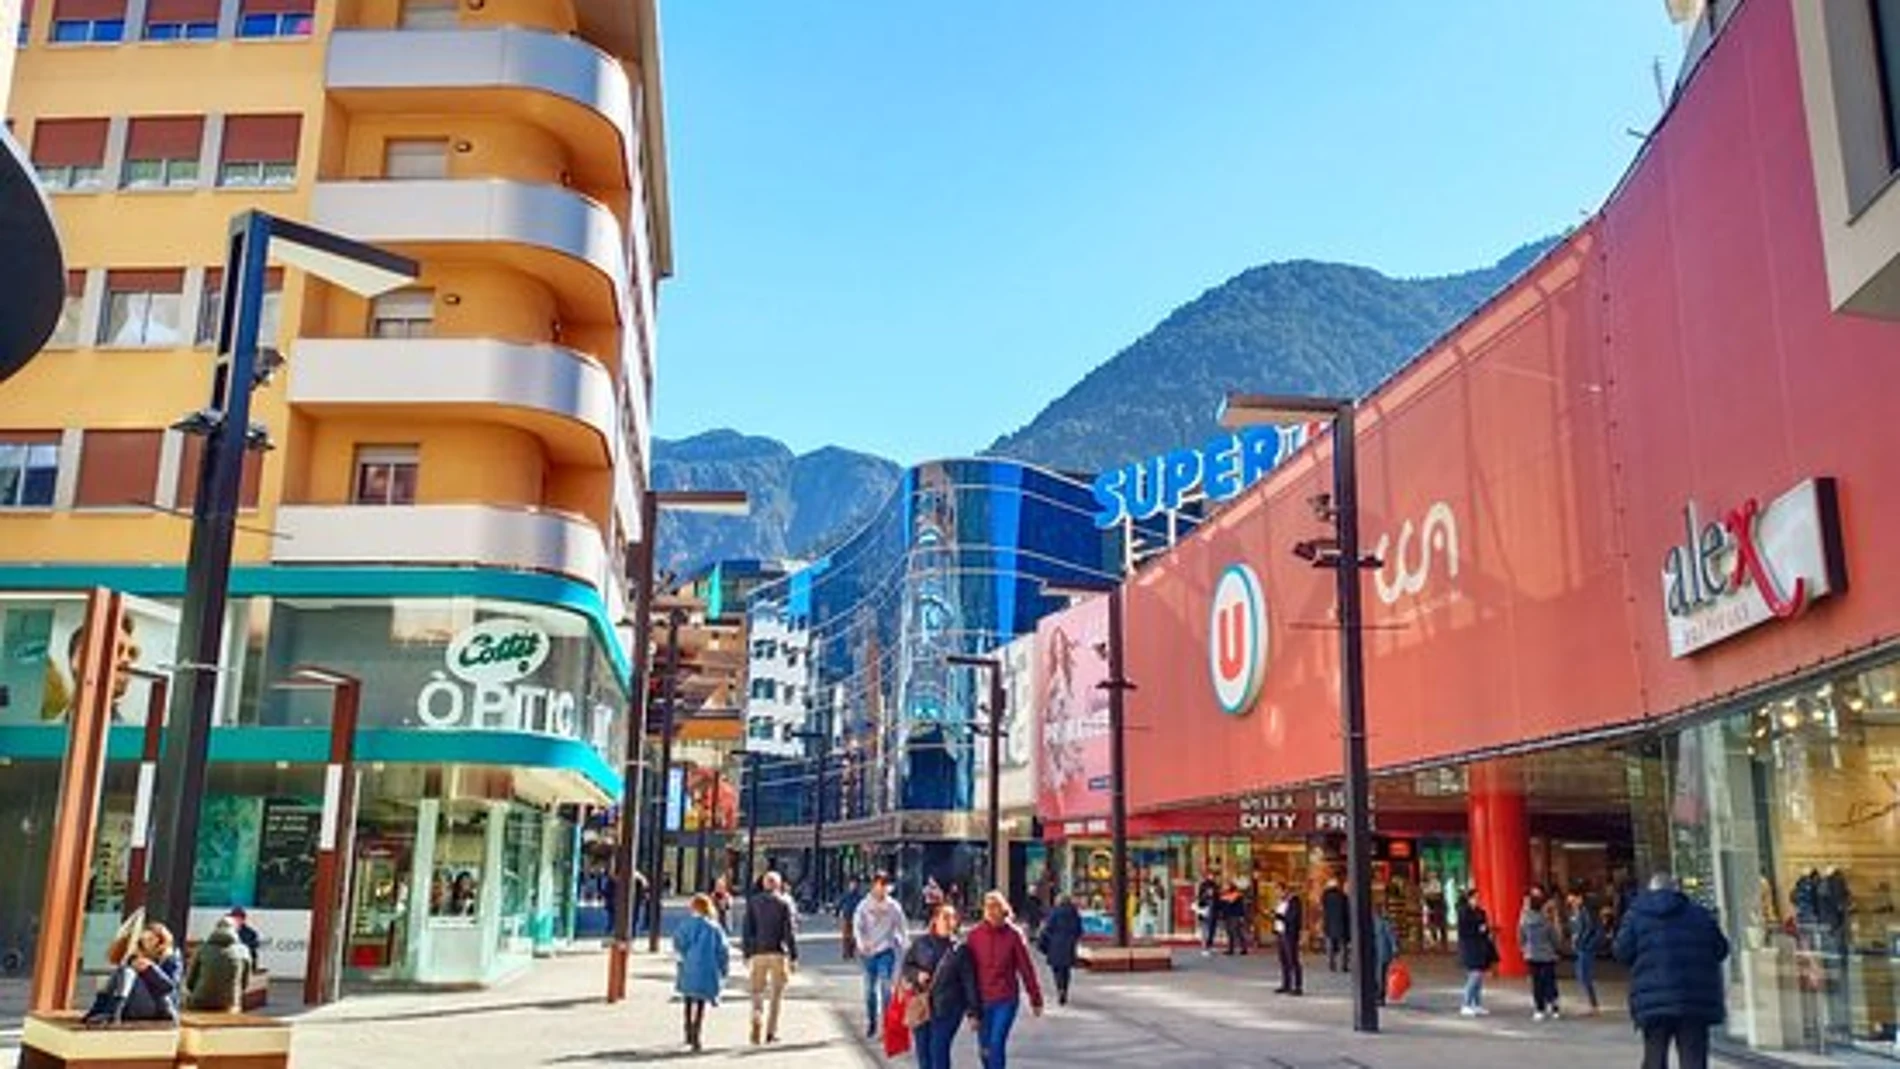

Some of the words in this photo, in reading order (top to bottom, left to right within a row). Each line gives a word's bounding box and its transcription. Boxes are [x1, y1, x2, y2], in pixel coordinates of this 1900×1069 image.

[1095, 424, 1280, 529] SUPER
[1665, 499, 1804, 619] alex
[1240, 812, 1297, 829] DUTY
